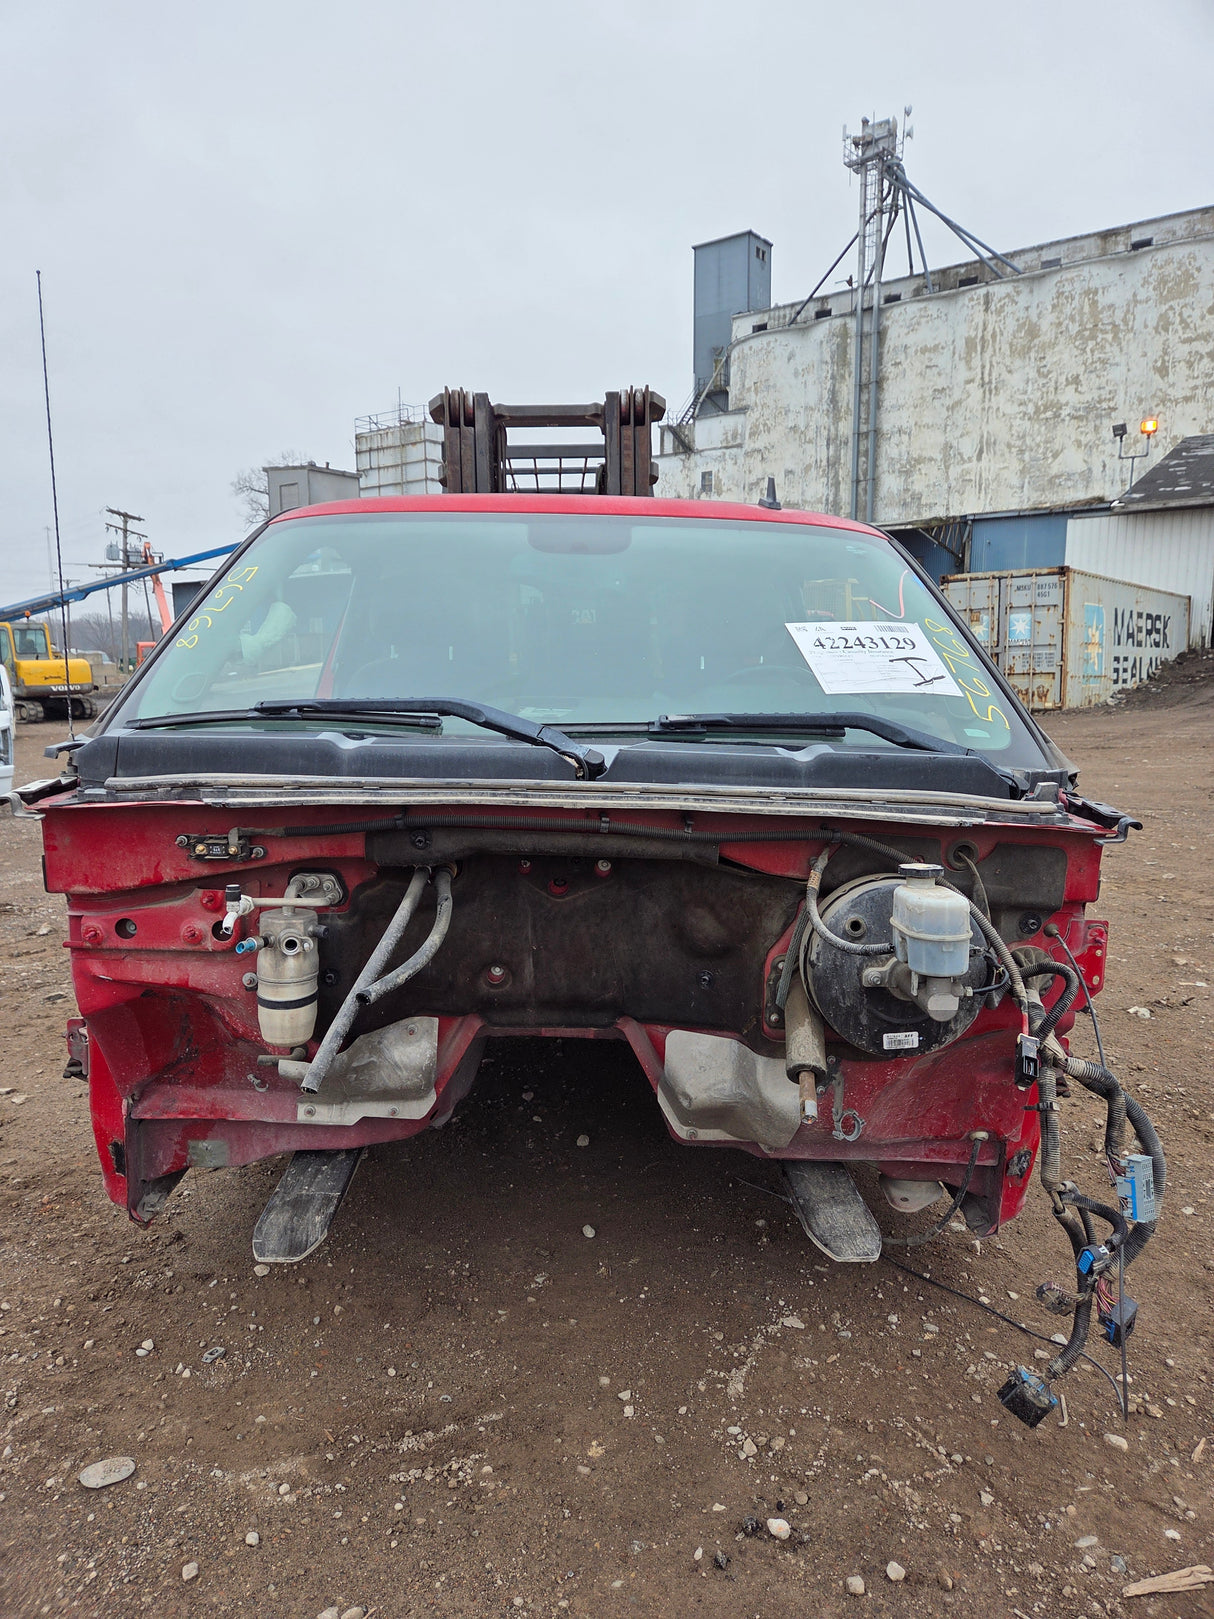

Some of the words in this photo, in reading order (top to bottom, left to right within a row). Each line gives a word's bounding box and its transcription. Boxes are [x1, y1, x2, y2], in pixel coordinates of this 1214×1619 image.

[1113, 607, 1171, 649] MAERSK
[813, 636, 917, 651] 42243129
[1112, 656, 1168, 684] SEALA
[50, 684, 81, 692] VOLVO
